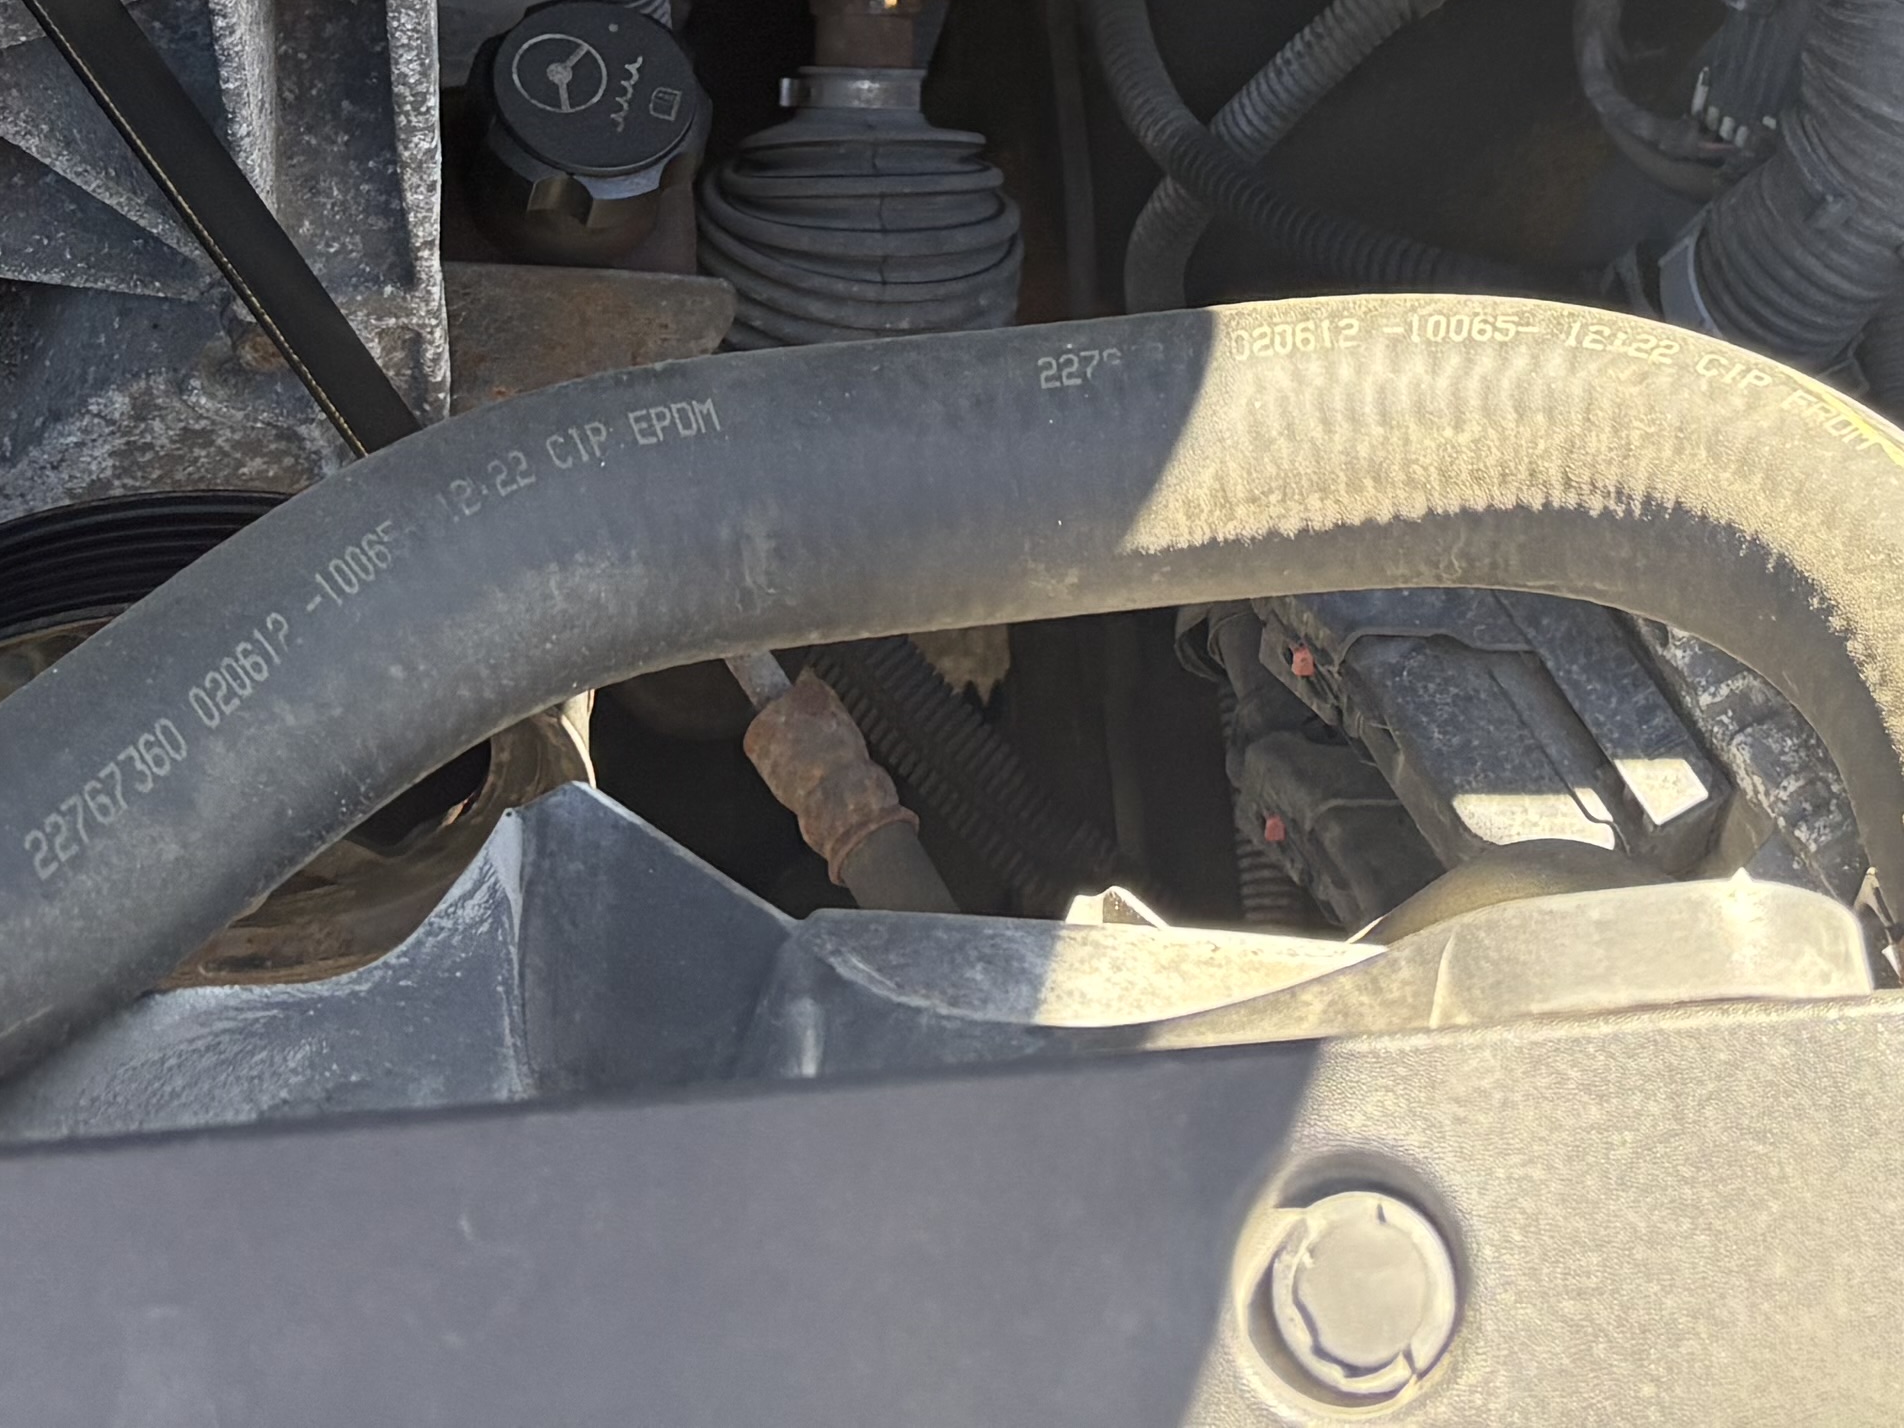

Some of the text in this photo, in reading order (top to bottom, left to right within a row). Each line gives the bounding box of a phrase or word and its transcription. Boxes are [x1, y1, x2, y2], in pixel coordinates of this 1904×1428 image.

[1234, 318, 1361, 361] 020612
[24, 717, 188, 881] 22767360
[544, 421, 608, 470] CIP
[627, 397, 723, 446] EPDM
